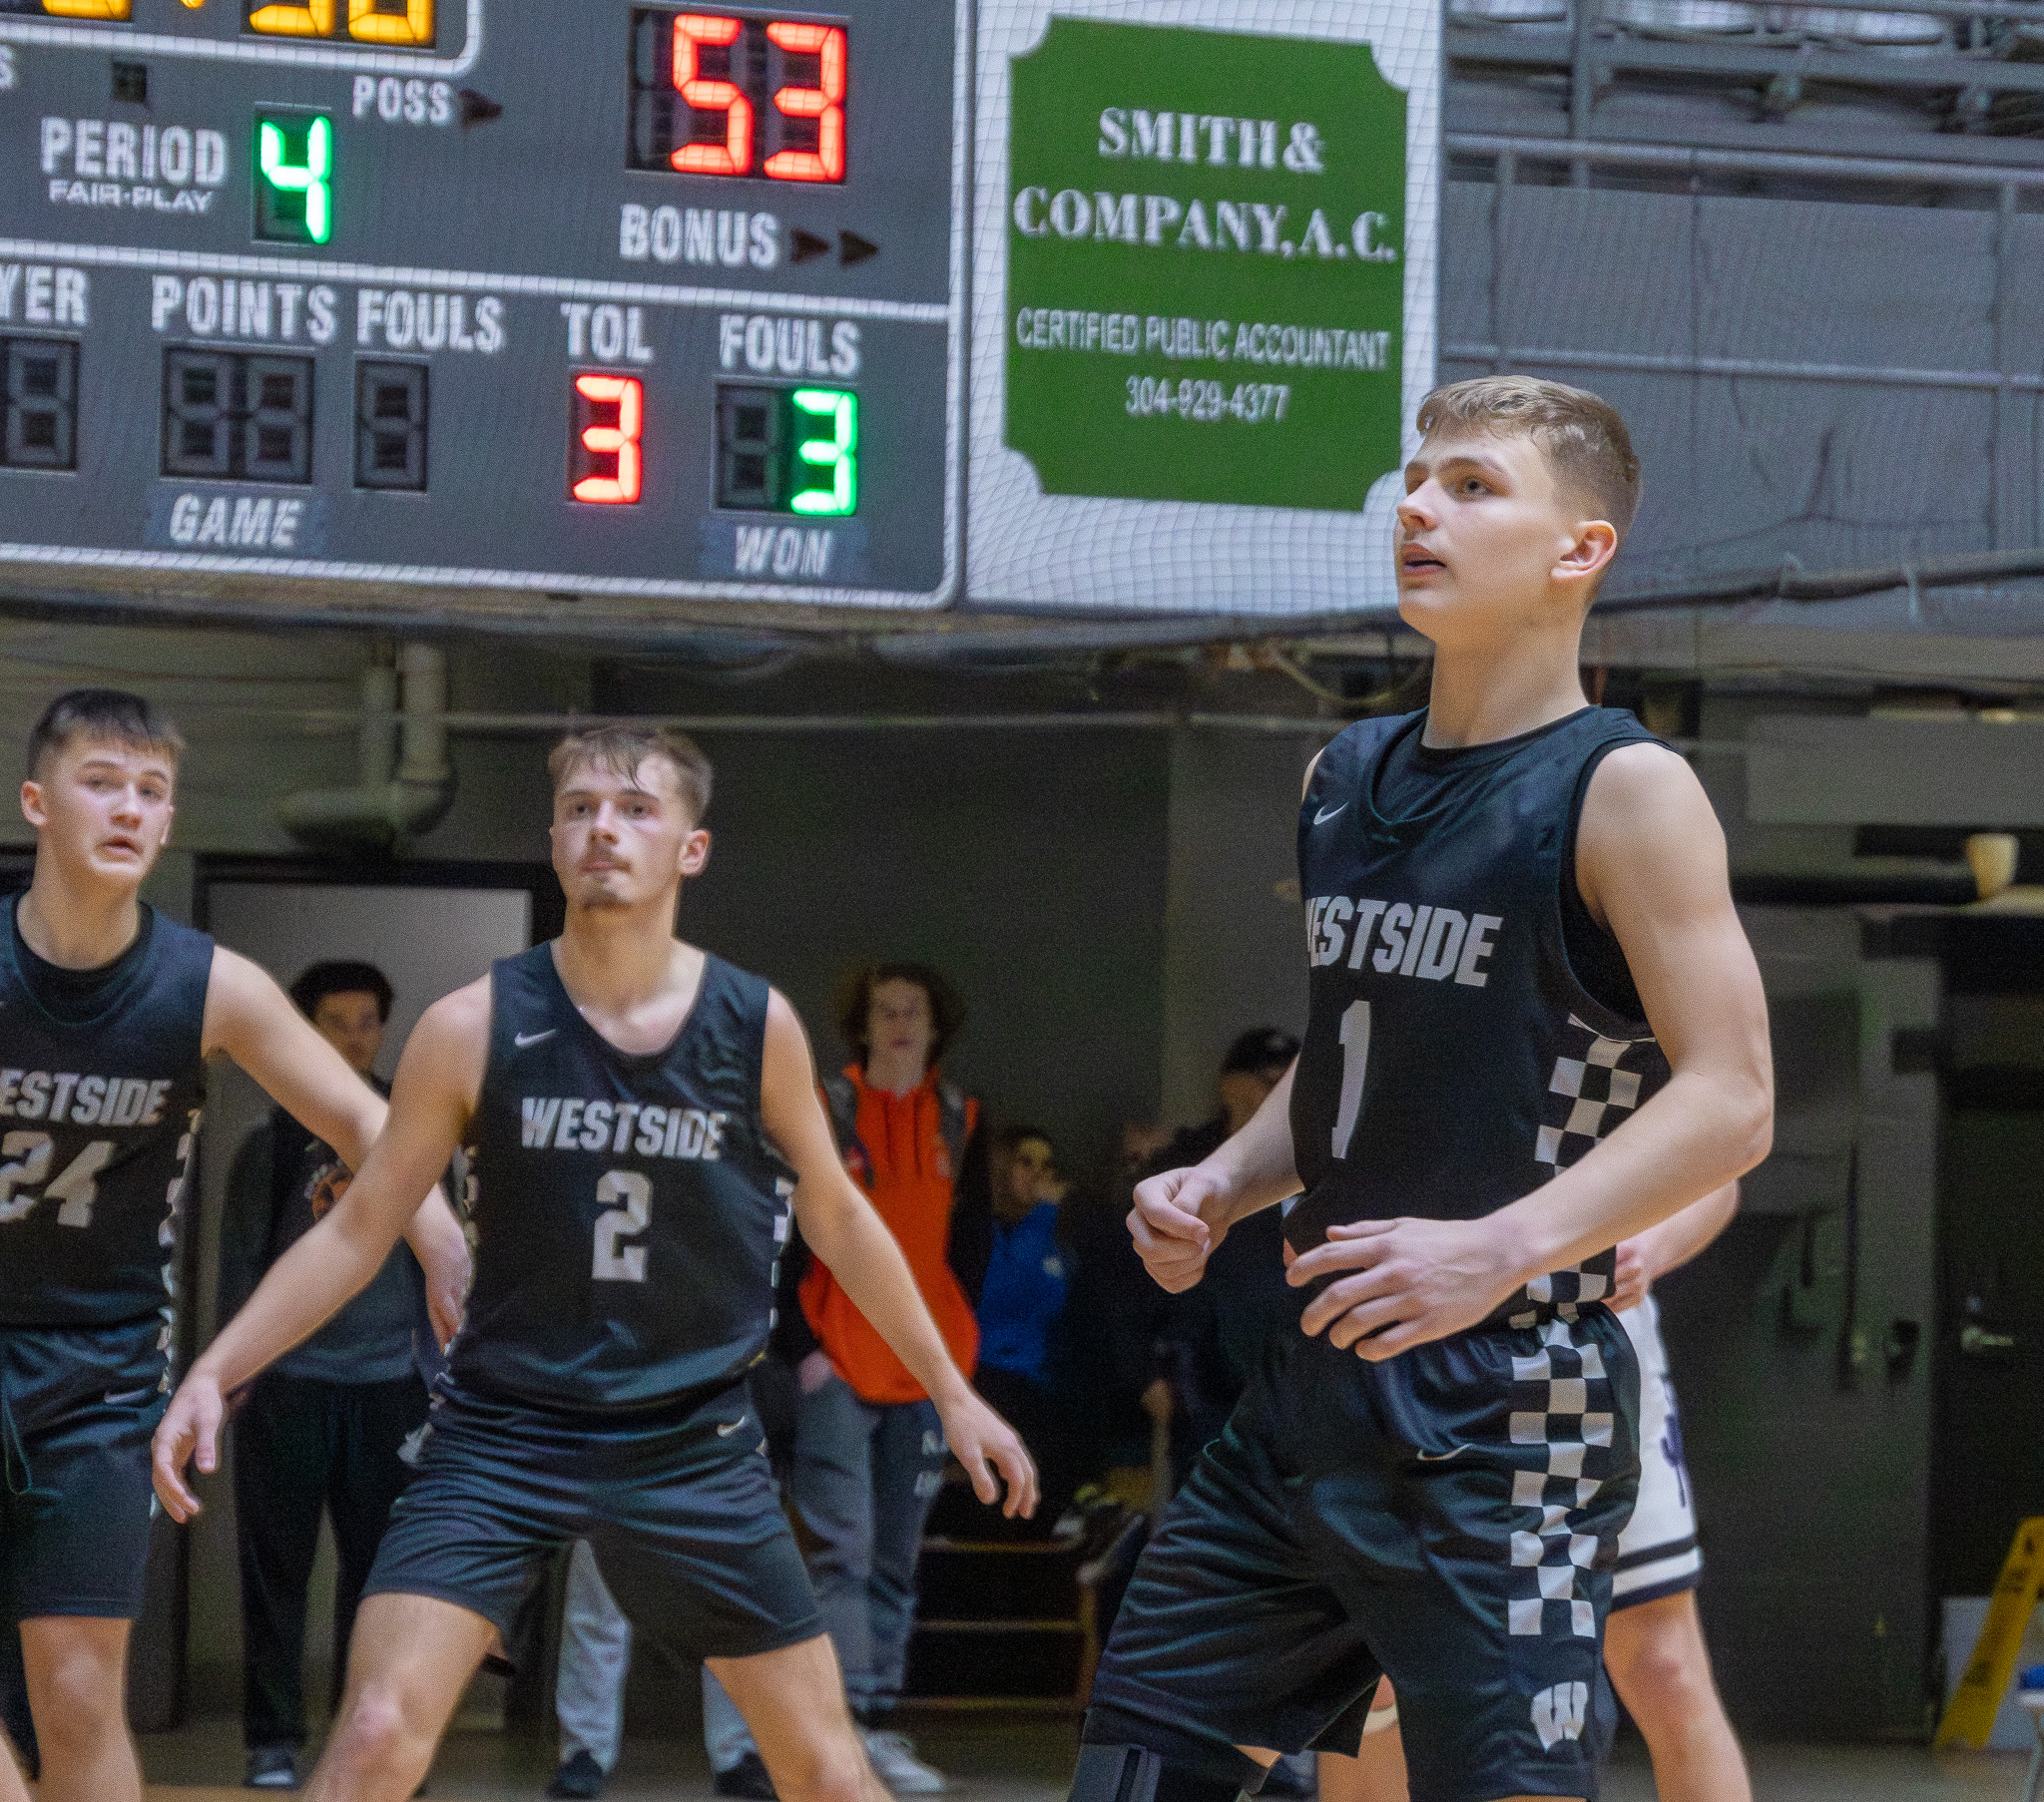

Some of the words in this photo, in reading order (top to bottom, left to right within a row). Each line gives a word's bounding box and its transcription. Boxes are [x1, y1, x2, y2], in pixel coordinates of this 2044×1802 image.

[351, 75, 455, 126] POSS
[671, 13, 848, 182] 53
[40, 116, 228, 187] PERIOD
[1098, 107, 1278, 169] SMITH
[1282, 122, 1326, 174] &
[259, 116, 333, 245] 4
[619, 203, 780, 269] BONUS
[151, 274, 339, 343] POINTS
[356, 288, 506, 354] FOULS
[561, 302, 653, 363] TOL
[1016, 306, 1139, 355] CERTIFIED
[1145, 315, 1231, 361] PUBLIC
[1233, 322, 1389, 369] ACCOUNTANT
[719, 313, 861, 377] FOULS
[1125, 375, 1291, 424] 304-929-4377
[573, 373, 644, 504] 3
[790, 388, 858, 516] 3
[169, 491, 304, 548] GAME
[734, 525, 833, 579] WON
[1330, 999, 1371, 1159] 1
[521, 1098, 727, 1160] WESTSIDE
[0, 1129, 118, 1229] 24
[592, 1169, 654, 1283] 2
